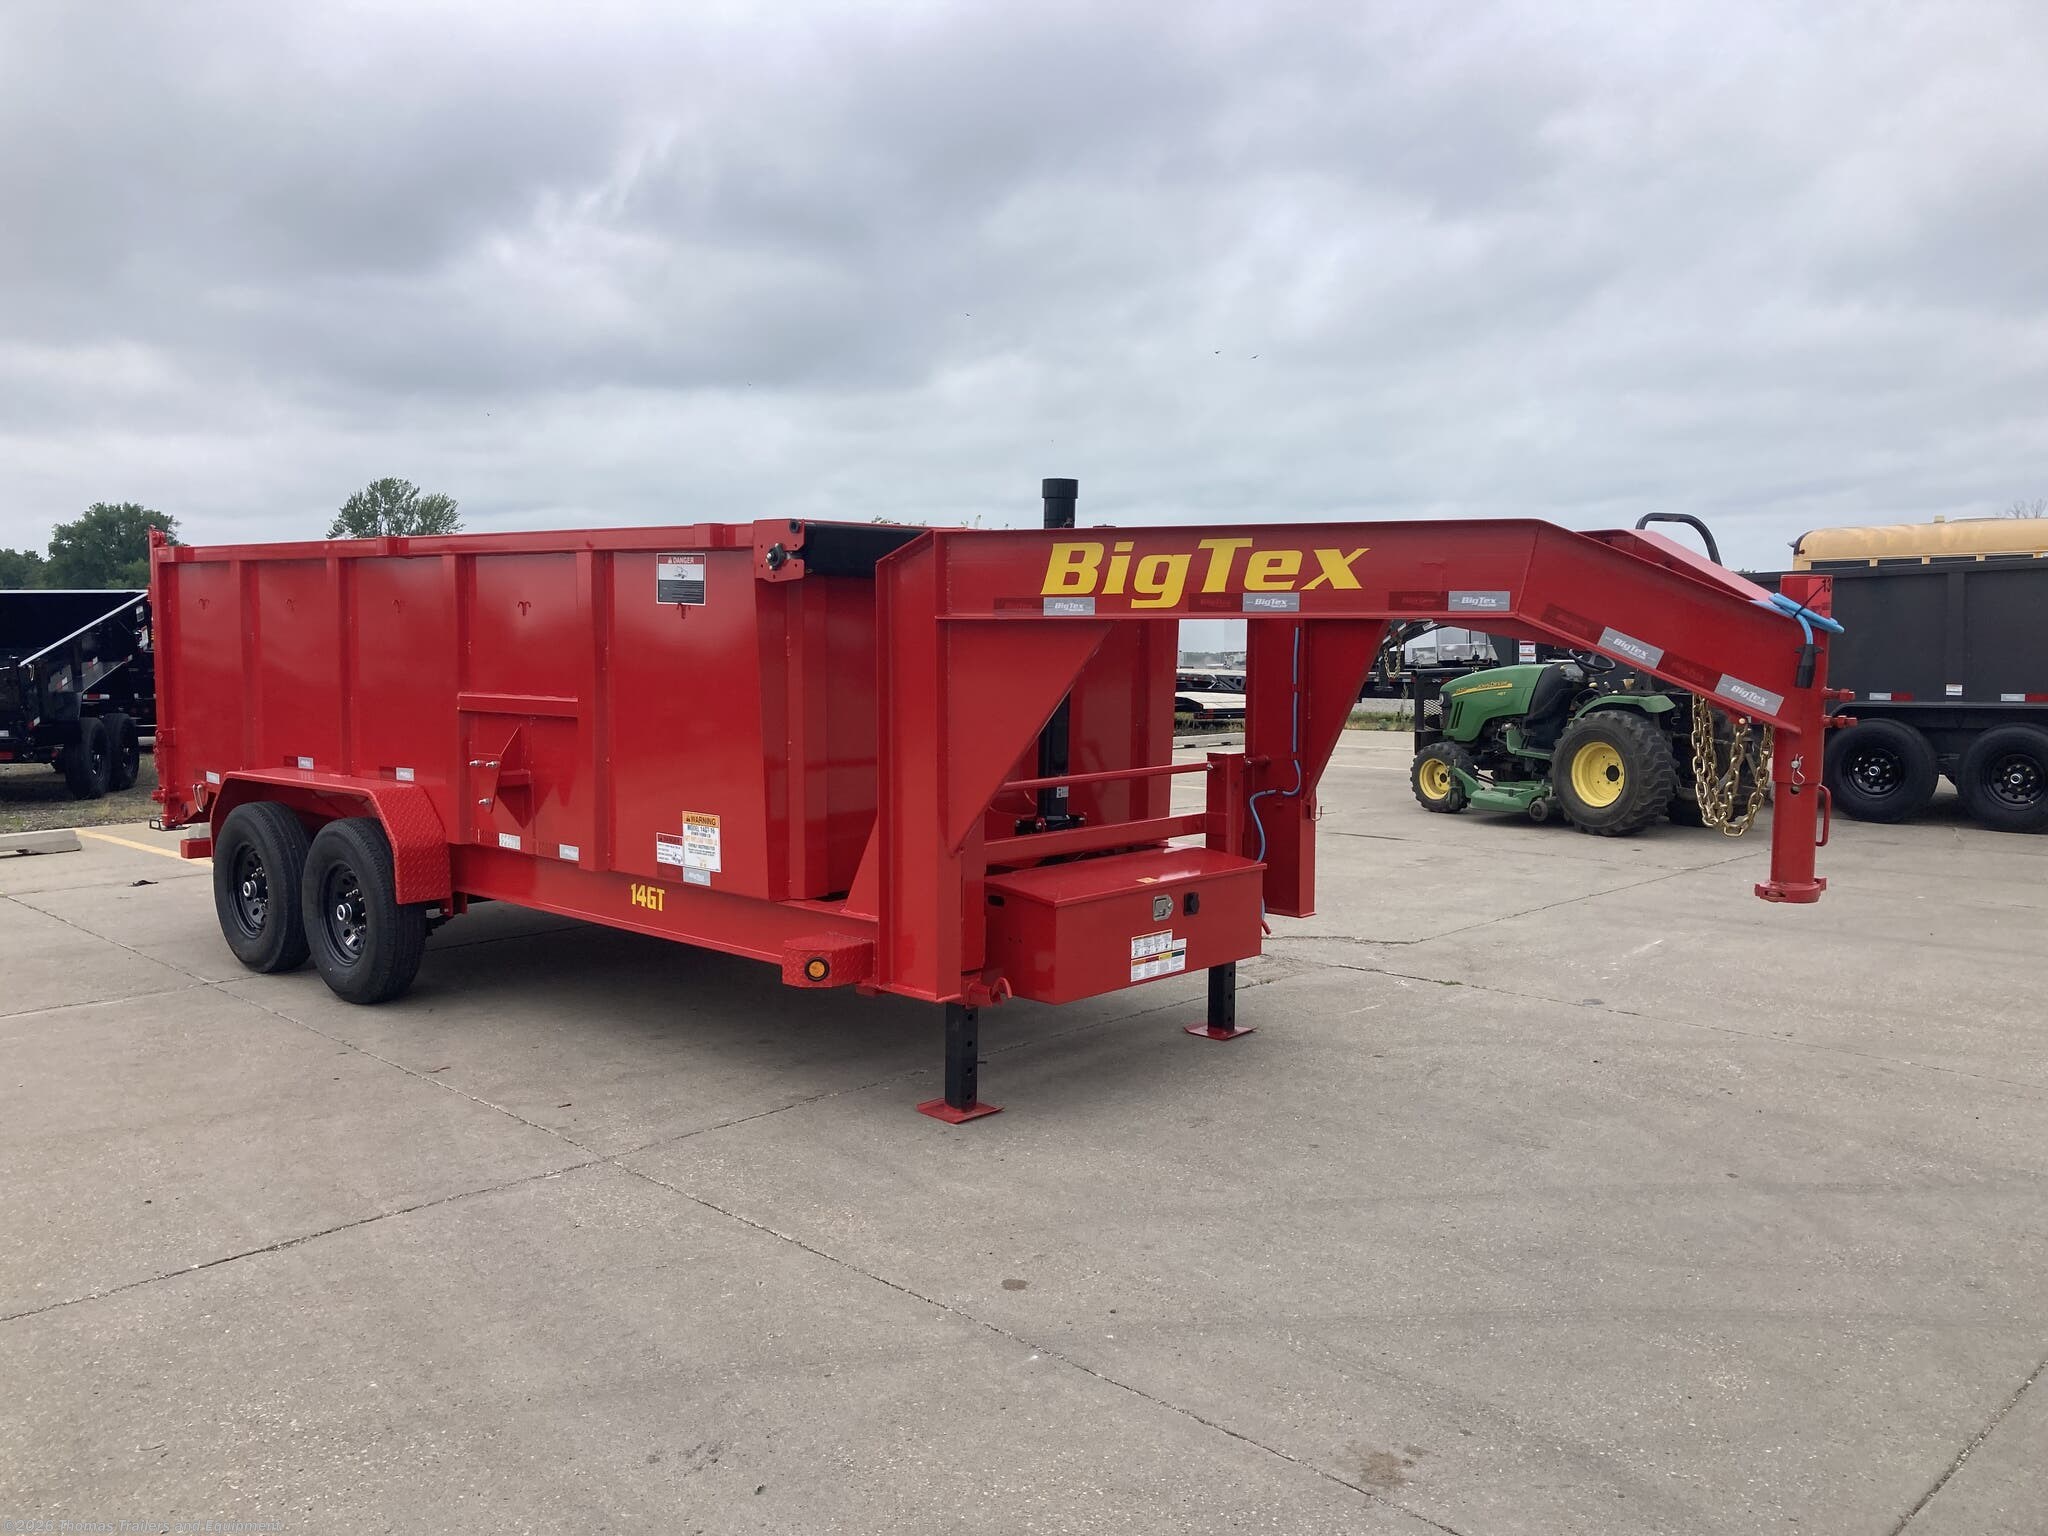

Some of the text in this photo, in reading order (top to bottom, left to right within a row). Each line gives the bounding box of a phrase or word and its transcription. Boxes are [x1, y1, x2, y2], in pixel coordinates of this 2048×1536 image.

[672, 556, 694, 564] DANGER
[1040, 538, 1370, 608] BigTex
[690, 815, 716, 826] WARNING
